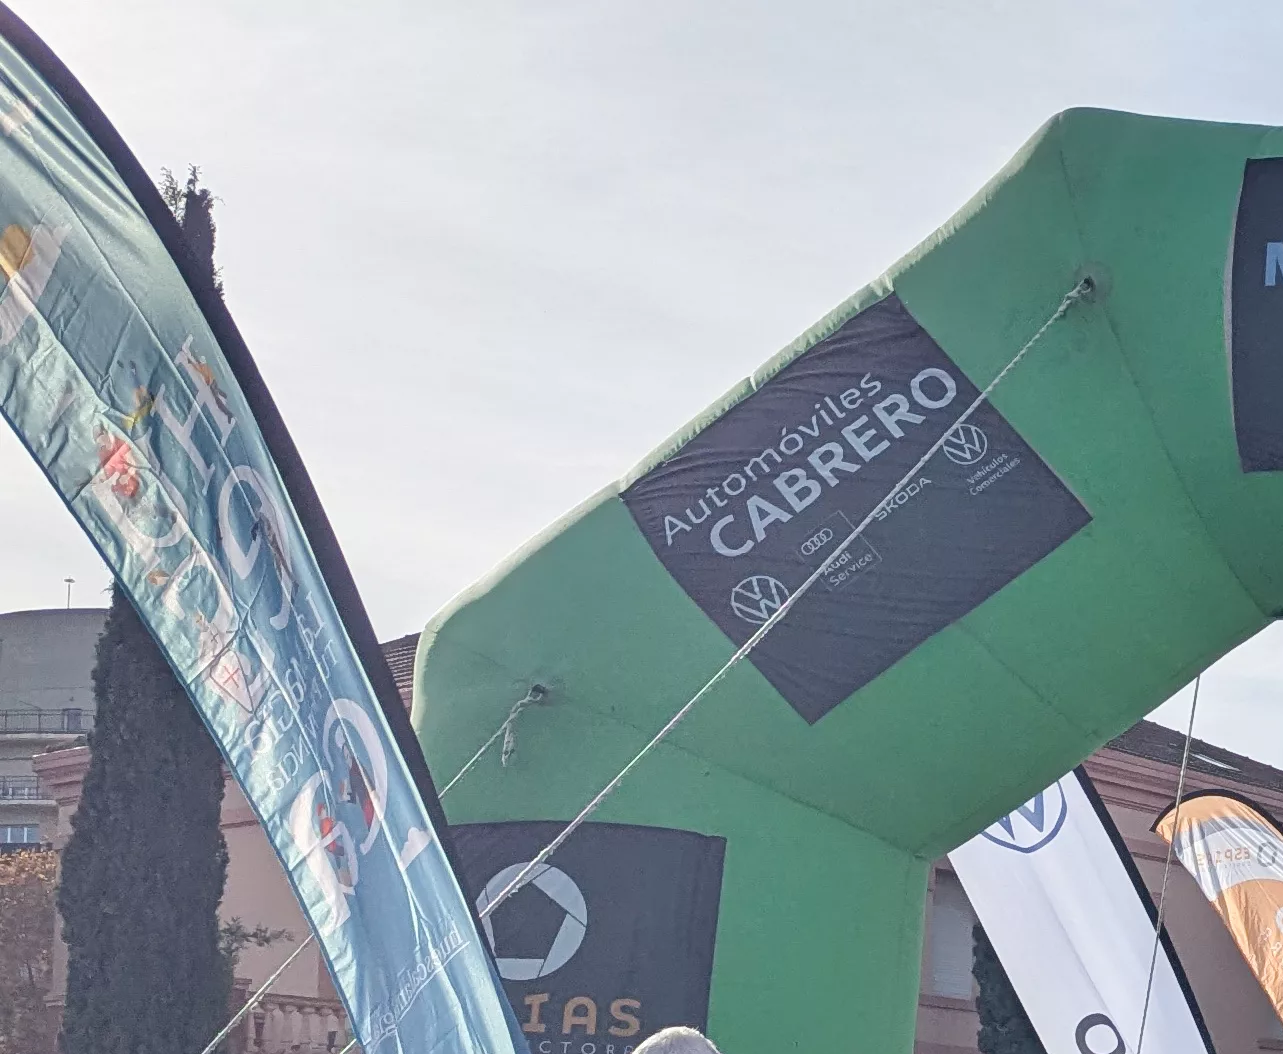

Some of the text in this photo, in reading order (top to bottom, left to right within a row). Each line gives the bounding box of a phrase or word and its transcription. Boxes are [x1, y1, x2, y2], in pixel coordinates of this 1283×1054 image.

[663, 372, 882, 547] Automóviles
[709, 367, 957, 558] CABRERO
[829, 552, 874, 587] Service
[523, 992, 641, 1038] IAS
